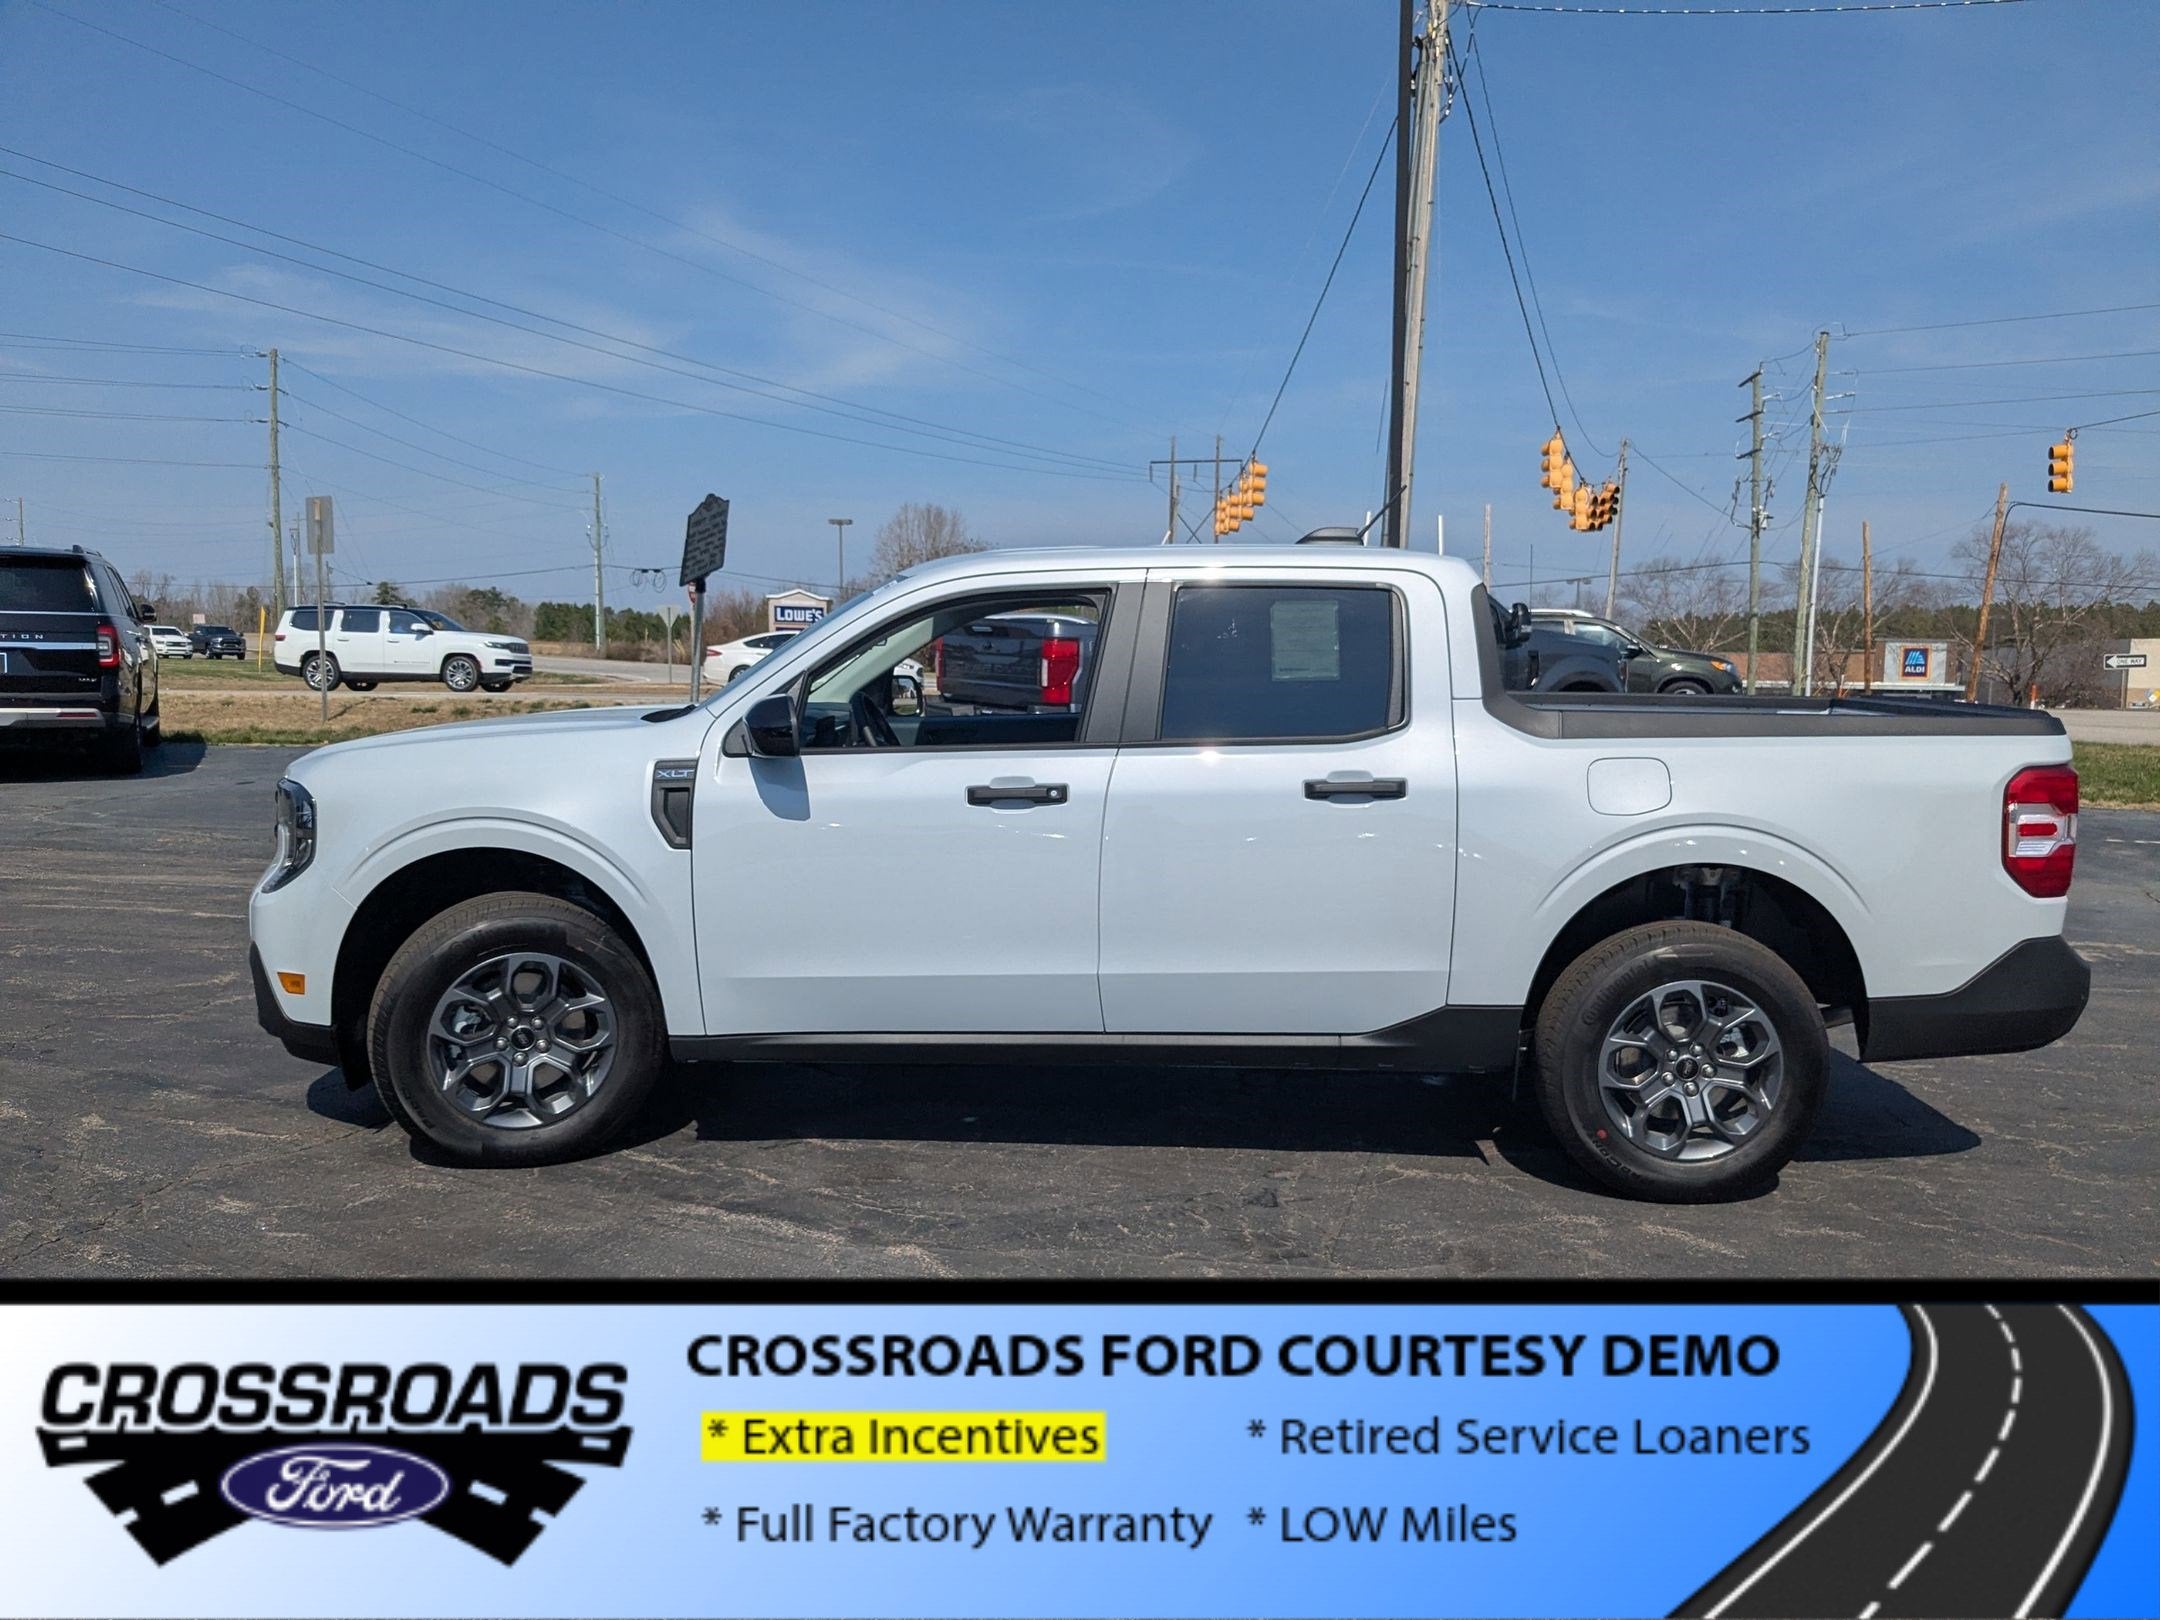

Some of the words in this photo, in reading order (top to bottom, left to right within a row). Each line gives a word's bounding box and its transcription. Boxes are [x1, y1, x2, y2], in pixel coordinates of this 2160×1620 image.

[776, 607, 823, 622] LOWE'S
[1904, 665, 1926, 674] ALDI
[656, 769, 695, 778] XLT
